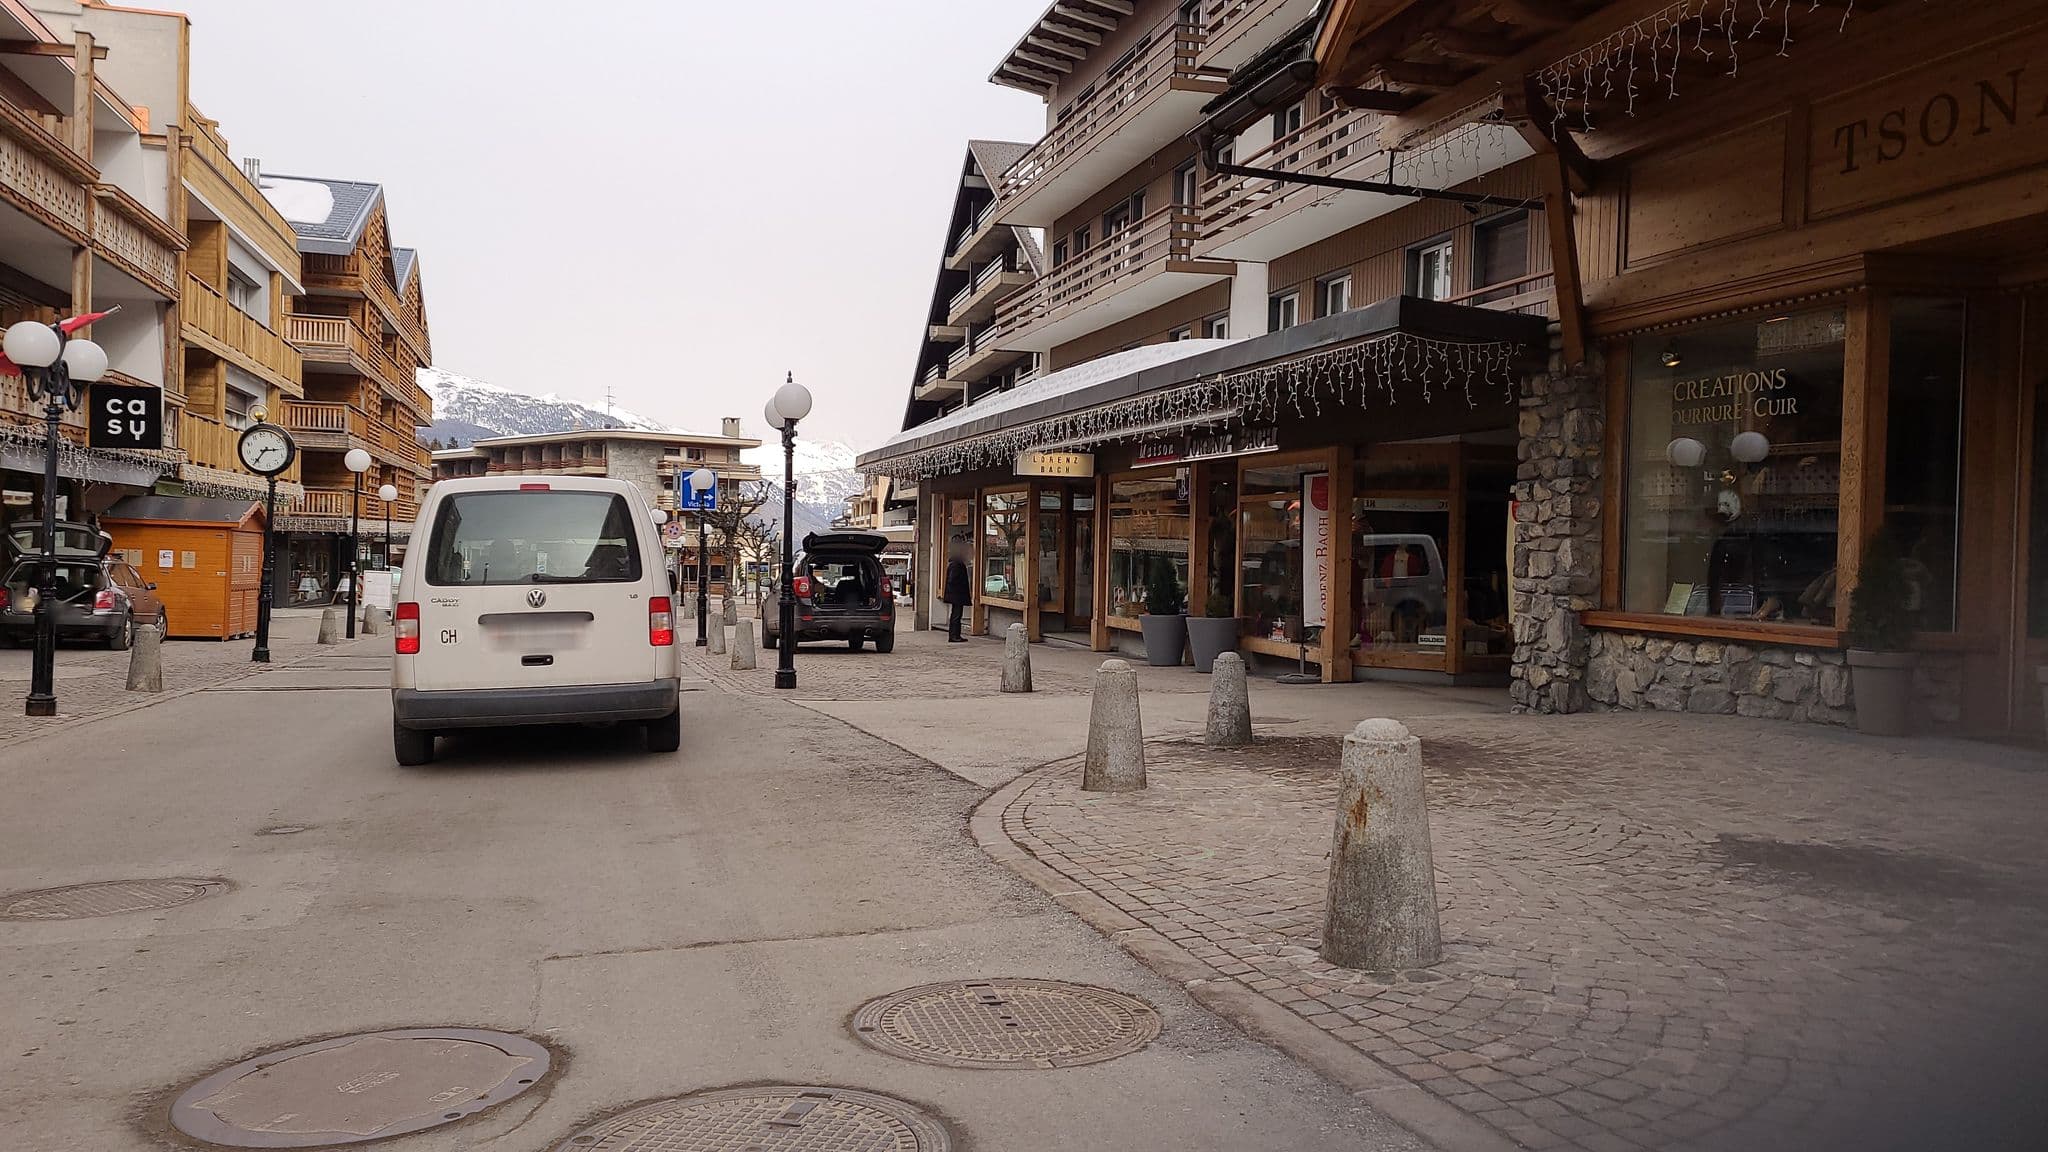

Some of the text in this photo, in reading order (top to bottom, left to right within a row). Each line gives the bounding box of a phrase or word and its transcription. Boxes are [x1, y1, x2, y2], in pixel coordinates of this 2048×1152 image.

[1834, 66, 2048, 175] TSON
[1673, 368, 1786, 402] CREATIONS
[106, 398, 146, 415] ca
[107, 419, 146, 441] sy
[1033, 455, 1080, 465] LORENZ
[1040, 465, 1070, 474] BACH
[440, 629, 457, 644] CH
